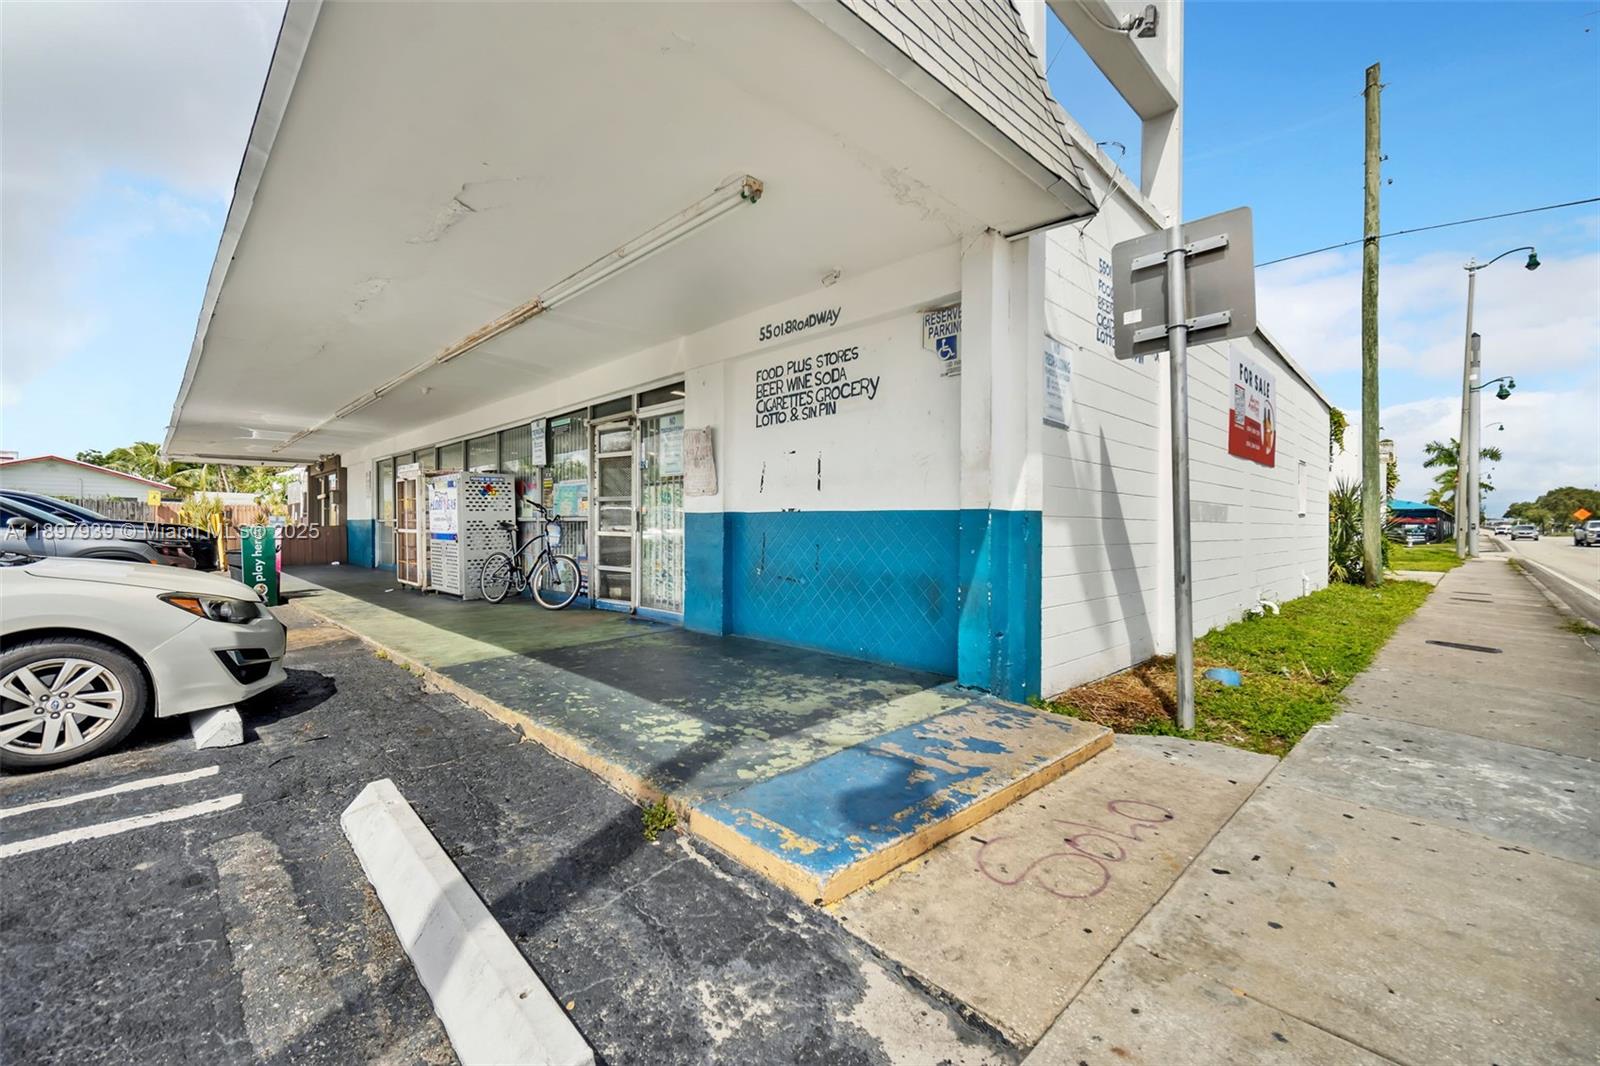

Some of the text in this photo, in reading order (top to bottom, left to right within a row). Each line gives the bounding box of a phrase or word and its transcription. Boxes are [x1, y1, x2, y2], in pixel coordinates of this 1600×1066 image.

[925, 307, 961, 327] RESERVE
[928, 321, 961, 339] PARKIN
[756, 346, 859, 382] FOOD PLUS STORES
[1239, 362, 1270, 399] FOR SALE
[755, 376, 880, 414] CIGARETTES GROCERY
[756, 367, 847, 400] BEER WINE SODA
[252, 559, 266, 582] play
